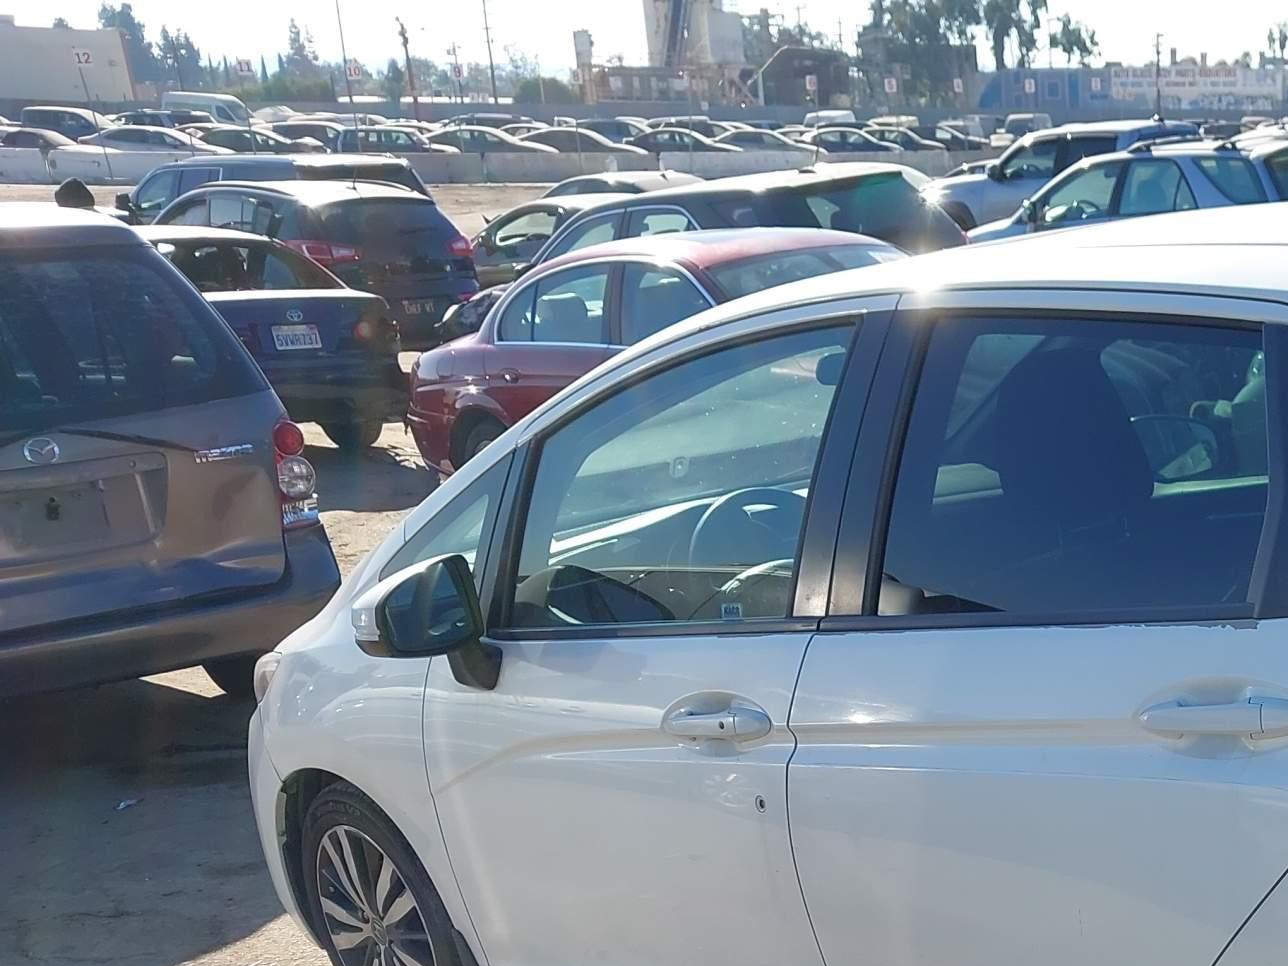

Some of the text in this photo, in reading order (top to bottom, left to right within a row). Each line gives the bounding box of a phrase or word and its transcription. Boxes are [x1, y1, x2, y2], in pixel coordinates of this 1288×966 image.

[75, 52, 91, 64] 12
[238, 61, 251, 73] 11
[347, 66, 360, 77] 10
